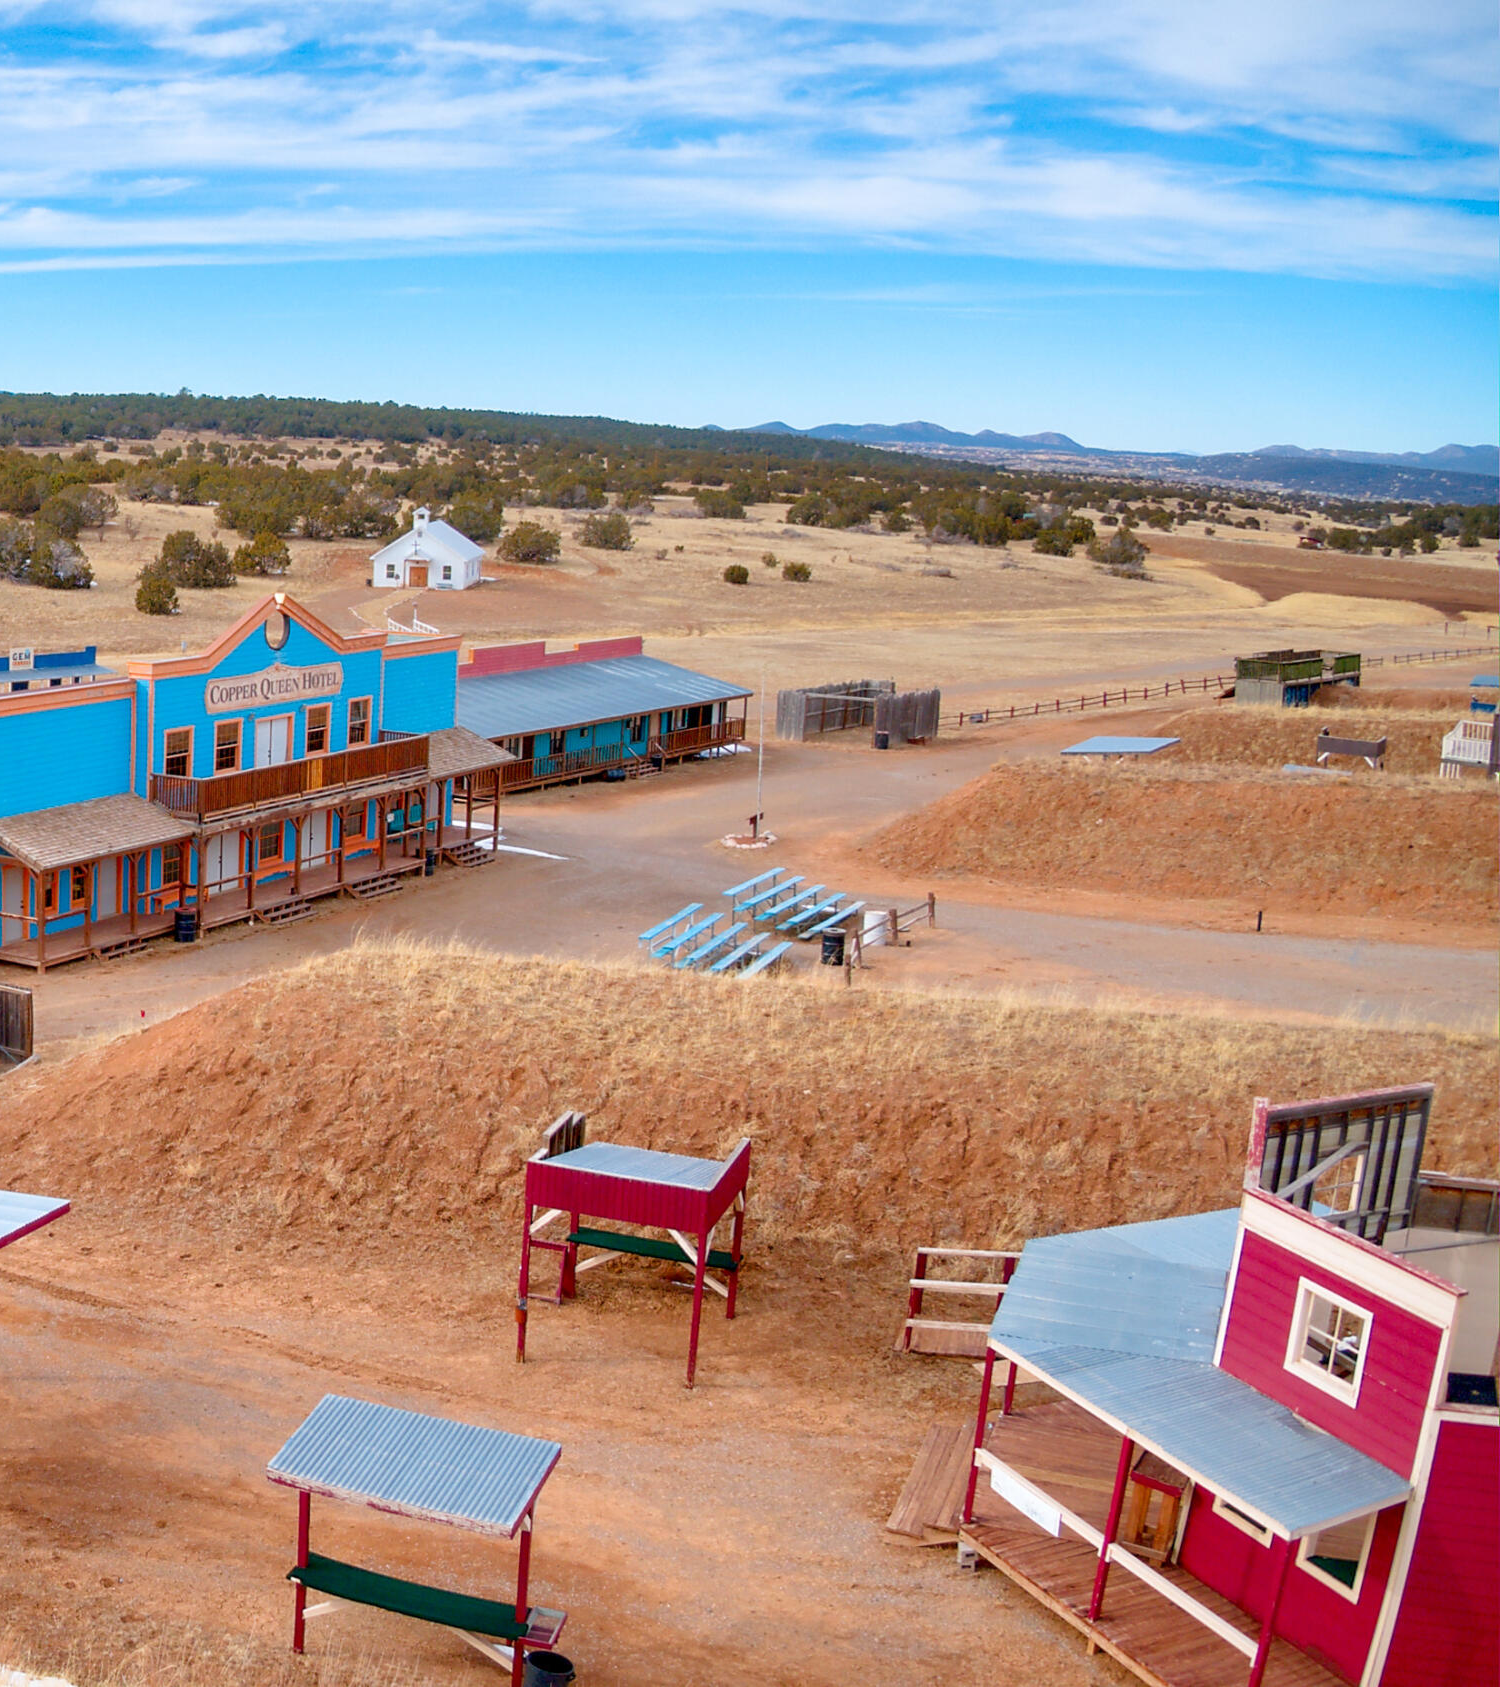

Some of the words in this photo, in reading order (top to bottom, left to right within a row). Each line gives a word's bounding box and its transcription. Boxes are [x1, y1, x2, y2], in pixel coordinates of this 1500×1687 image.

[12, 652, 31, 661] GEM
[210, 684, 257, 705] COPPER
[260, 677, 300, 700] QUEEN
[303, 672, 339, 690] HOTEL
